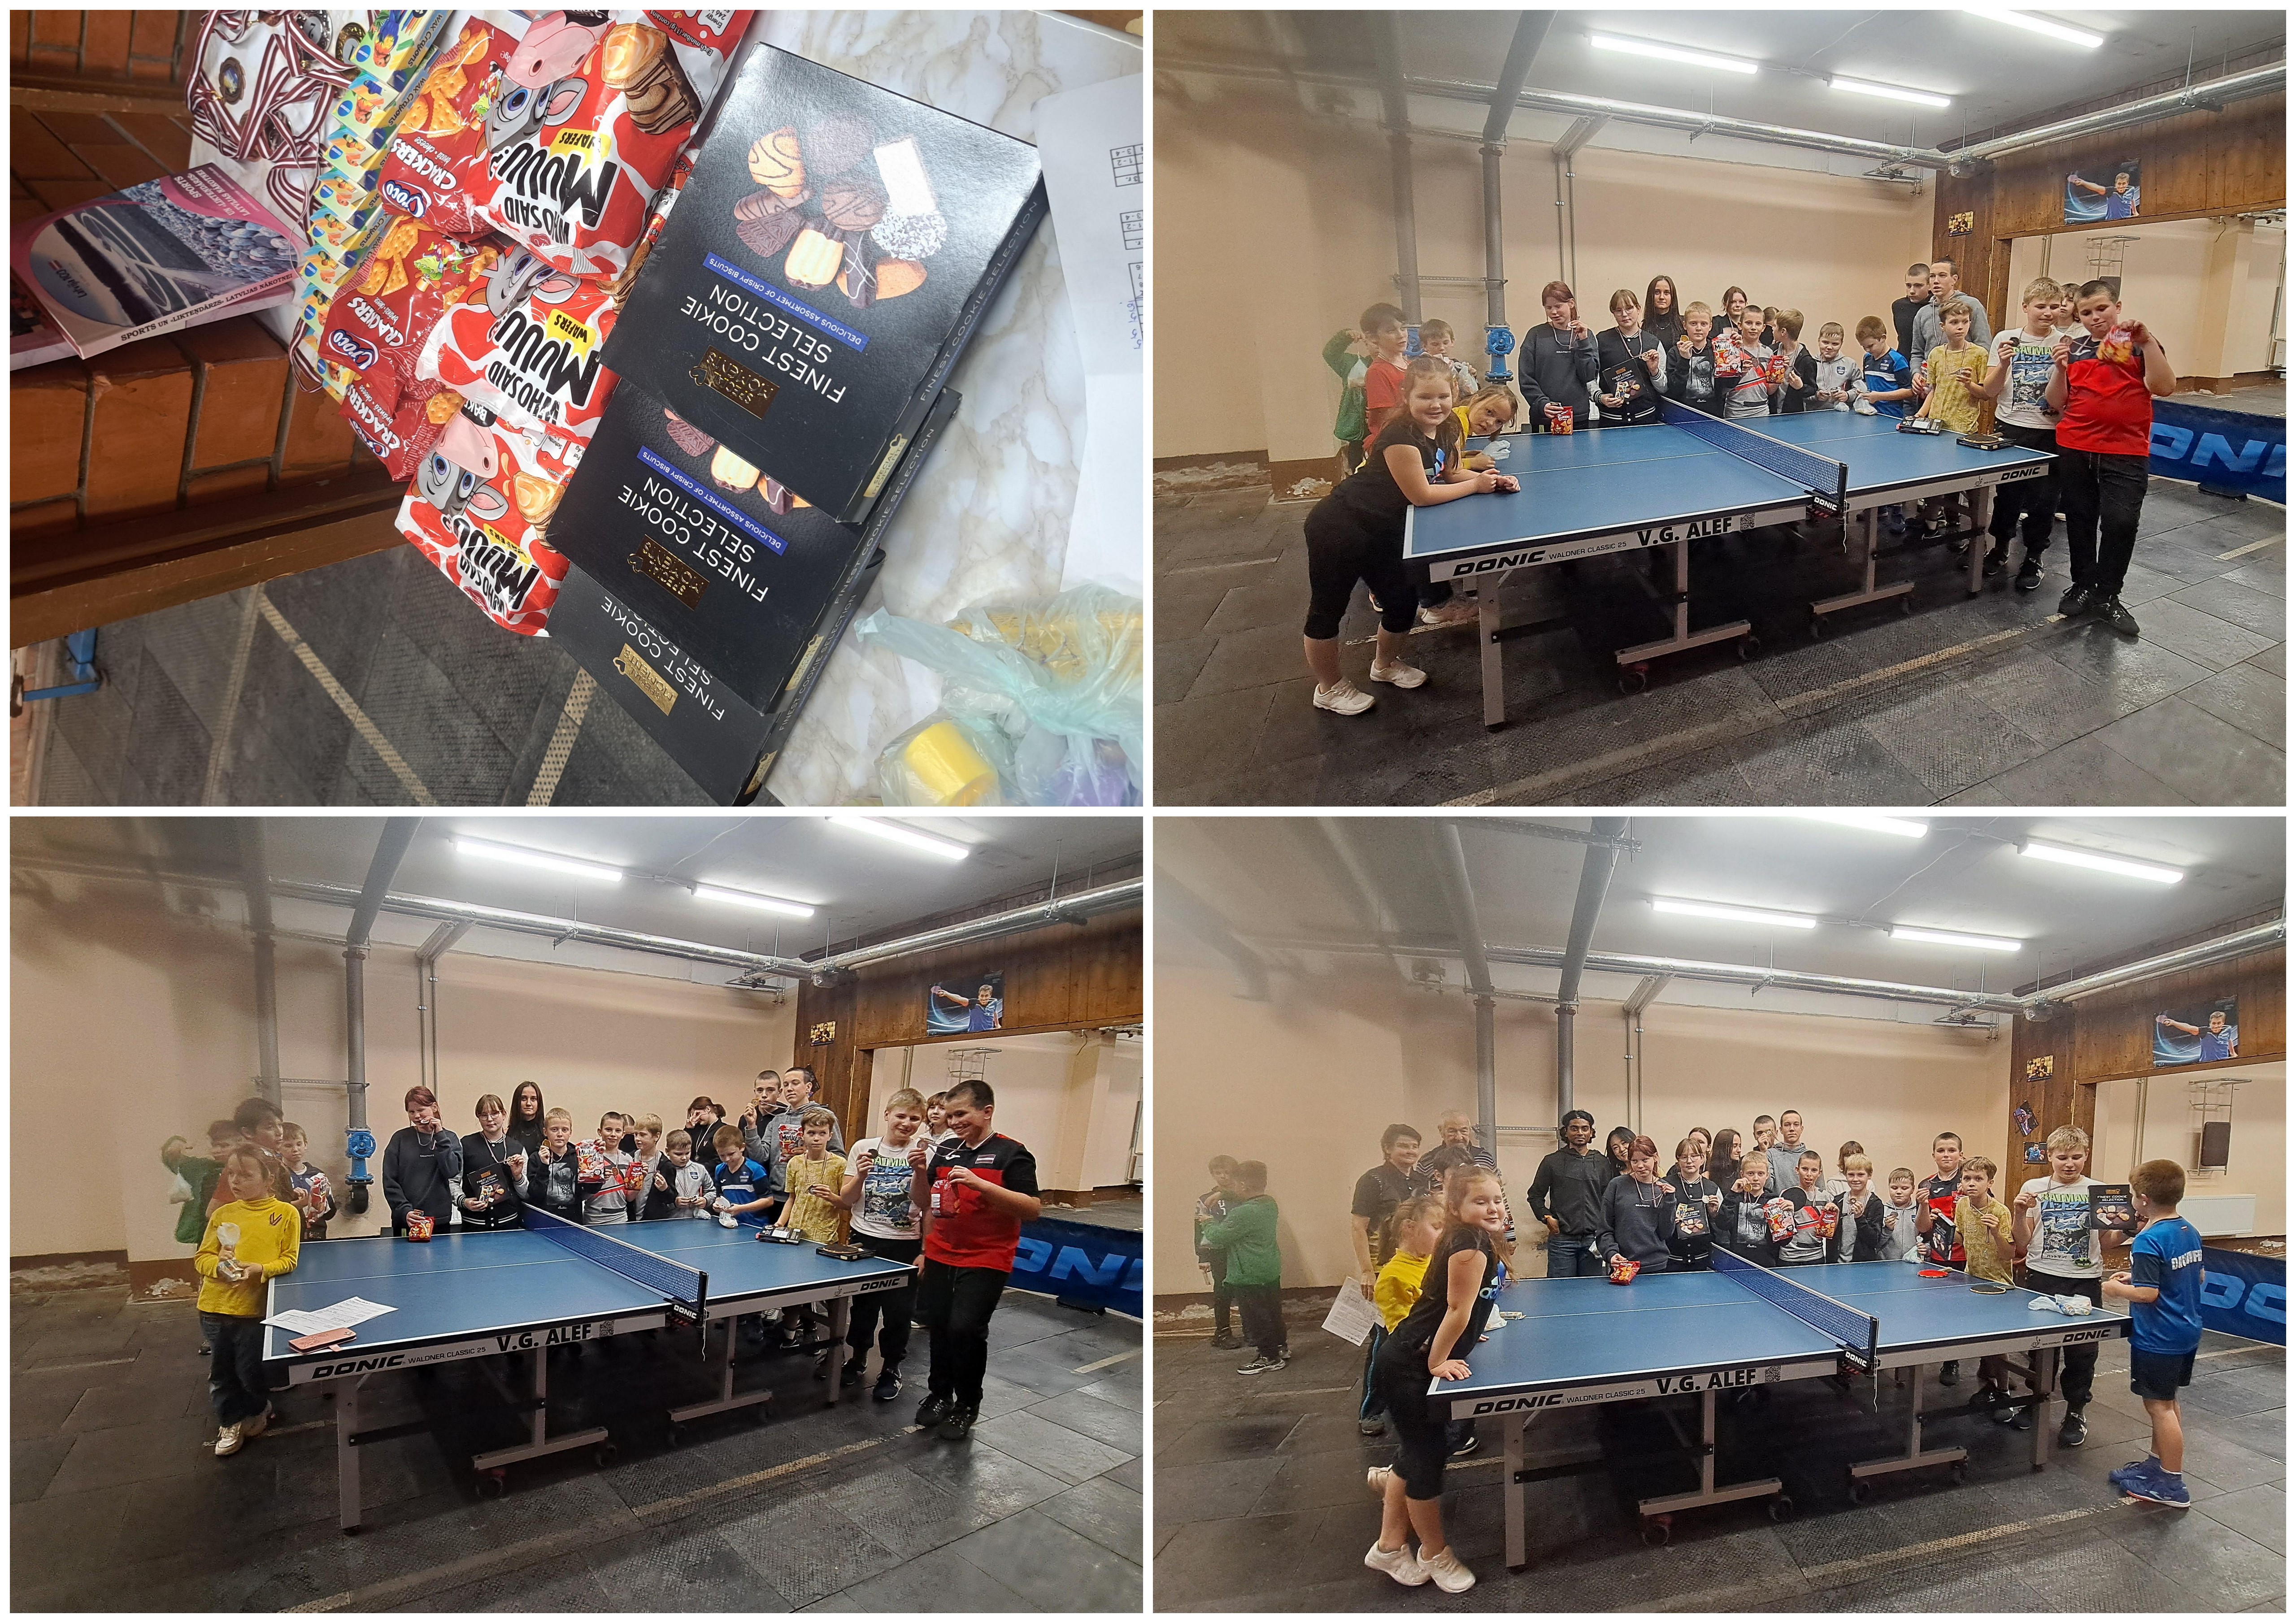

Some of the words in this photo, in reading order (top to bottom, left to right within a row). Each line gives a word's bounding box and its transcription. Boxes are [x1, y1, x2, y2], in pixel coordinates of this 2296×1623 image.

[429, 13, 443, 31] WAX
[648, 10, 670, 26] contains
[668, 22, 683, 35] (11g)
[704, 12, 723, 29] Energy
[406, 30, 433, 67] Crayons
[680, 31, 701, 47] minibar
[699, 43, 713, 56] Each
[412, 77, 426, 94] WAX
[686, 70, 698, 91] suggestion
[387, 92, 414, 126] Crayons
[413, 135, 436, 154] cheese
[391, 138, 455, 193] CRACKERS
[173, 174, 202, 200] SPORTS
[382, 180, 425, 220] Croco
[220, 191, 251, 217] LATVIJAS
[223, 206, 235, 216] UN
[504, 196, 543, 230] SAID
[359, 217, 385, 248] Crayons
[536, 207, 570, 245] WHO
[371, 236, 382, 251] WAX
[708, 256, 740, 278] BISCUITS
[739, 272, 766, 292] CRISPY
[120, 322, 157, 342] SPORTS
[158, 319, 169, 327] UN
[225, 286, 258, 302] LATVIJAS
[258, 273, 293, 290] NĀKOTNEI
[764, 286, 777, 298] OF
[919, 349, 953, 402] FINEST
[949, 289, 987, 347] COOKIE
[985, 200, 1039, 286] SELECTION
[345, 293, 407, 351] CRACKERS
[679, 295, 761, 352] COOKIE
[775, 293, 821, 323] ASSORTMET
[552, 312, 589, 343] WAFERS
[708, 283, 833, 365] SELECTION
[819, 317, 862, 346] DELICIOUS
[330, 330, 371, 372] Croco
[486, 359, 522, 399] SAID
[704, 350, 774, 400] MOMENTS
[708, 370, 755, 405] SPECIAL
[761, 342, 847, 404] FINEST
[1616, 373, 1631, 382] SELECTION
[357, 383, 374, 404] cheese
[344, 383, 403, 451] CRACKERS
[573, 452, 581, 460] Fat
[640, 450, 671, 473] BISCUITS
[873, 449, 896, 485] SPECIAL
[546, 467, 565, 481] contains
[669, 469, 695, 489] CRISPY
[2000, 467, 2040, 481] DONIC
[692, 484, 704, 496] OF
[1813, 496, 1838, 512] DONIC
[616, 484, 693, 547] COOKIE
[641, 476, 757, 563] SELECTION
[702, 491, 745, 523] ASSORTMET
[834, 558, 862, 606] FINEST
[861, 506, 891, 556] COOKIE
[890, 427, 936, 503] SELECTION
[743, 518, 783, 549] DELICIOUS
[1452, 550, 1546, 577] DONIC
[1548, 549, 1586, 560] WALDNER
[1587, 542, 1617, 554] CLASSIC
[1637, 525, 1680, 547] V.G.
[1686, 516, 1733, 539] ALEF
[639, 540, 705, 594] MOMENTS
[644, 560, 687, 595] SPECIAL
[692, 539, 769, 602] FINEST
[598, 595, 663, 660] COOKIE
[621, 647, 676, 701] MOMENTS
[779, 695, 801, 732] FINEST
[798, 655, 822, 695] COOKIE
[819, 593, 858, 654] SELECTION
[626, 665, 662, 702] SPECIAL
[663, 657, 726, 720] FINEST
[860, 1278, 901, 1292] DONIC
[673, 1303, 697, 1319] DONIC
[2063, 1328, 2111, 1343] DONIC
[311, 1354, 405, 1380] DONIC
[408, 1353, 445, 1364] WALDNER
[446, 1348, 475, 1358] CLASSIC
[496, 1333, 539, 1352] V.G.
[545, 1324, 592, 1345] ALEF
[1845, 1351, 1867, 1367] DONIC
[1473, 1393, 1564, 1415] DONIC
[1566, 1394, 1603, 1404] WALDNER
[1605, 1389, 1635, 1400] CLASSIC
[1656, 1376, 1701, 1395] V.G.
[1707, 1368, 1756, 1389] ALEF
